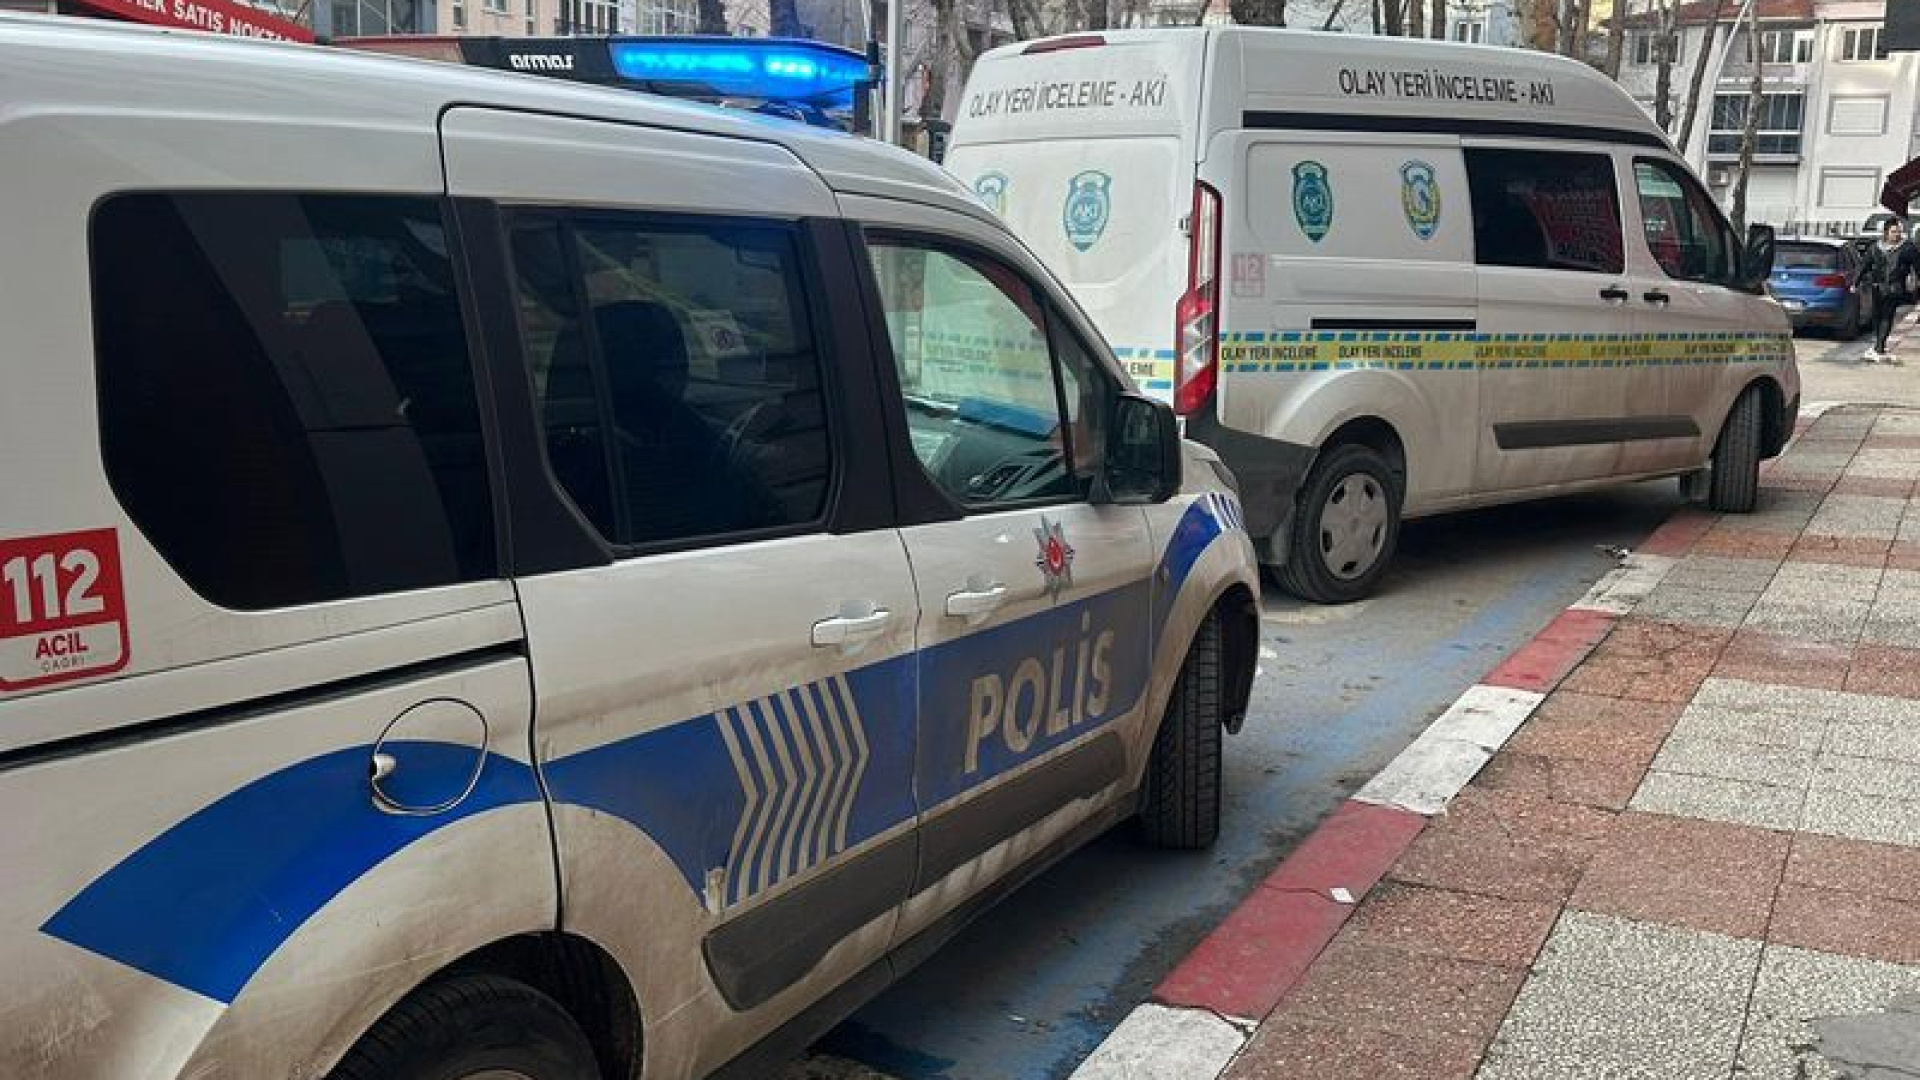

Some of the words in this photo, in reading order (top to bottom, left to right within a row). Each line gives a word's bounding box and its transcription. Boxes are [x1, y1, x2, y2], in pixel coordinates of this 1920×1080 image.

[1338, 68, 1386, 96] OLAY
[3, 549, 105, 623] 112
[964, 609, 1115, 774] POLİS
